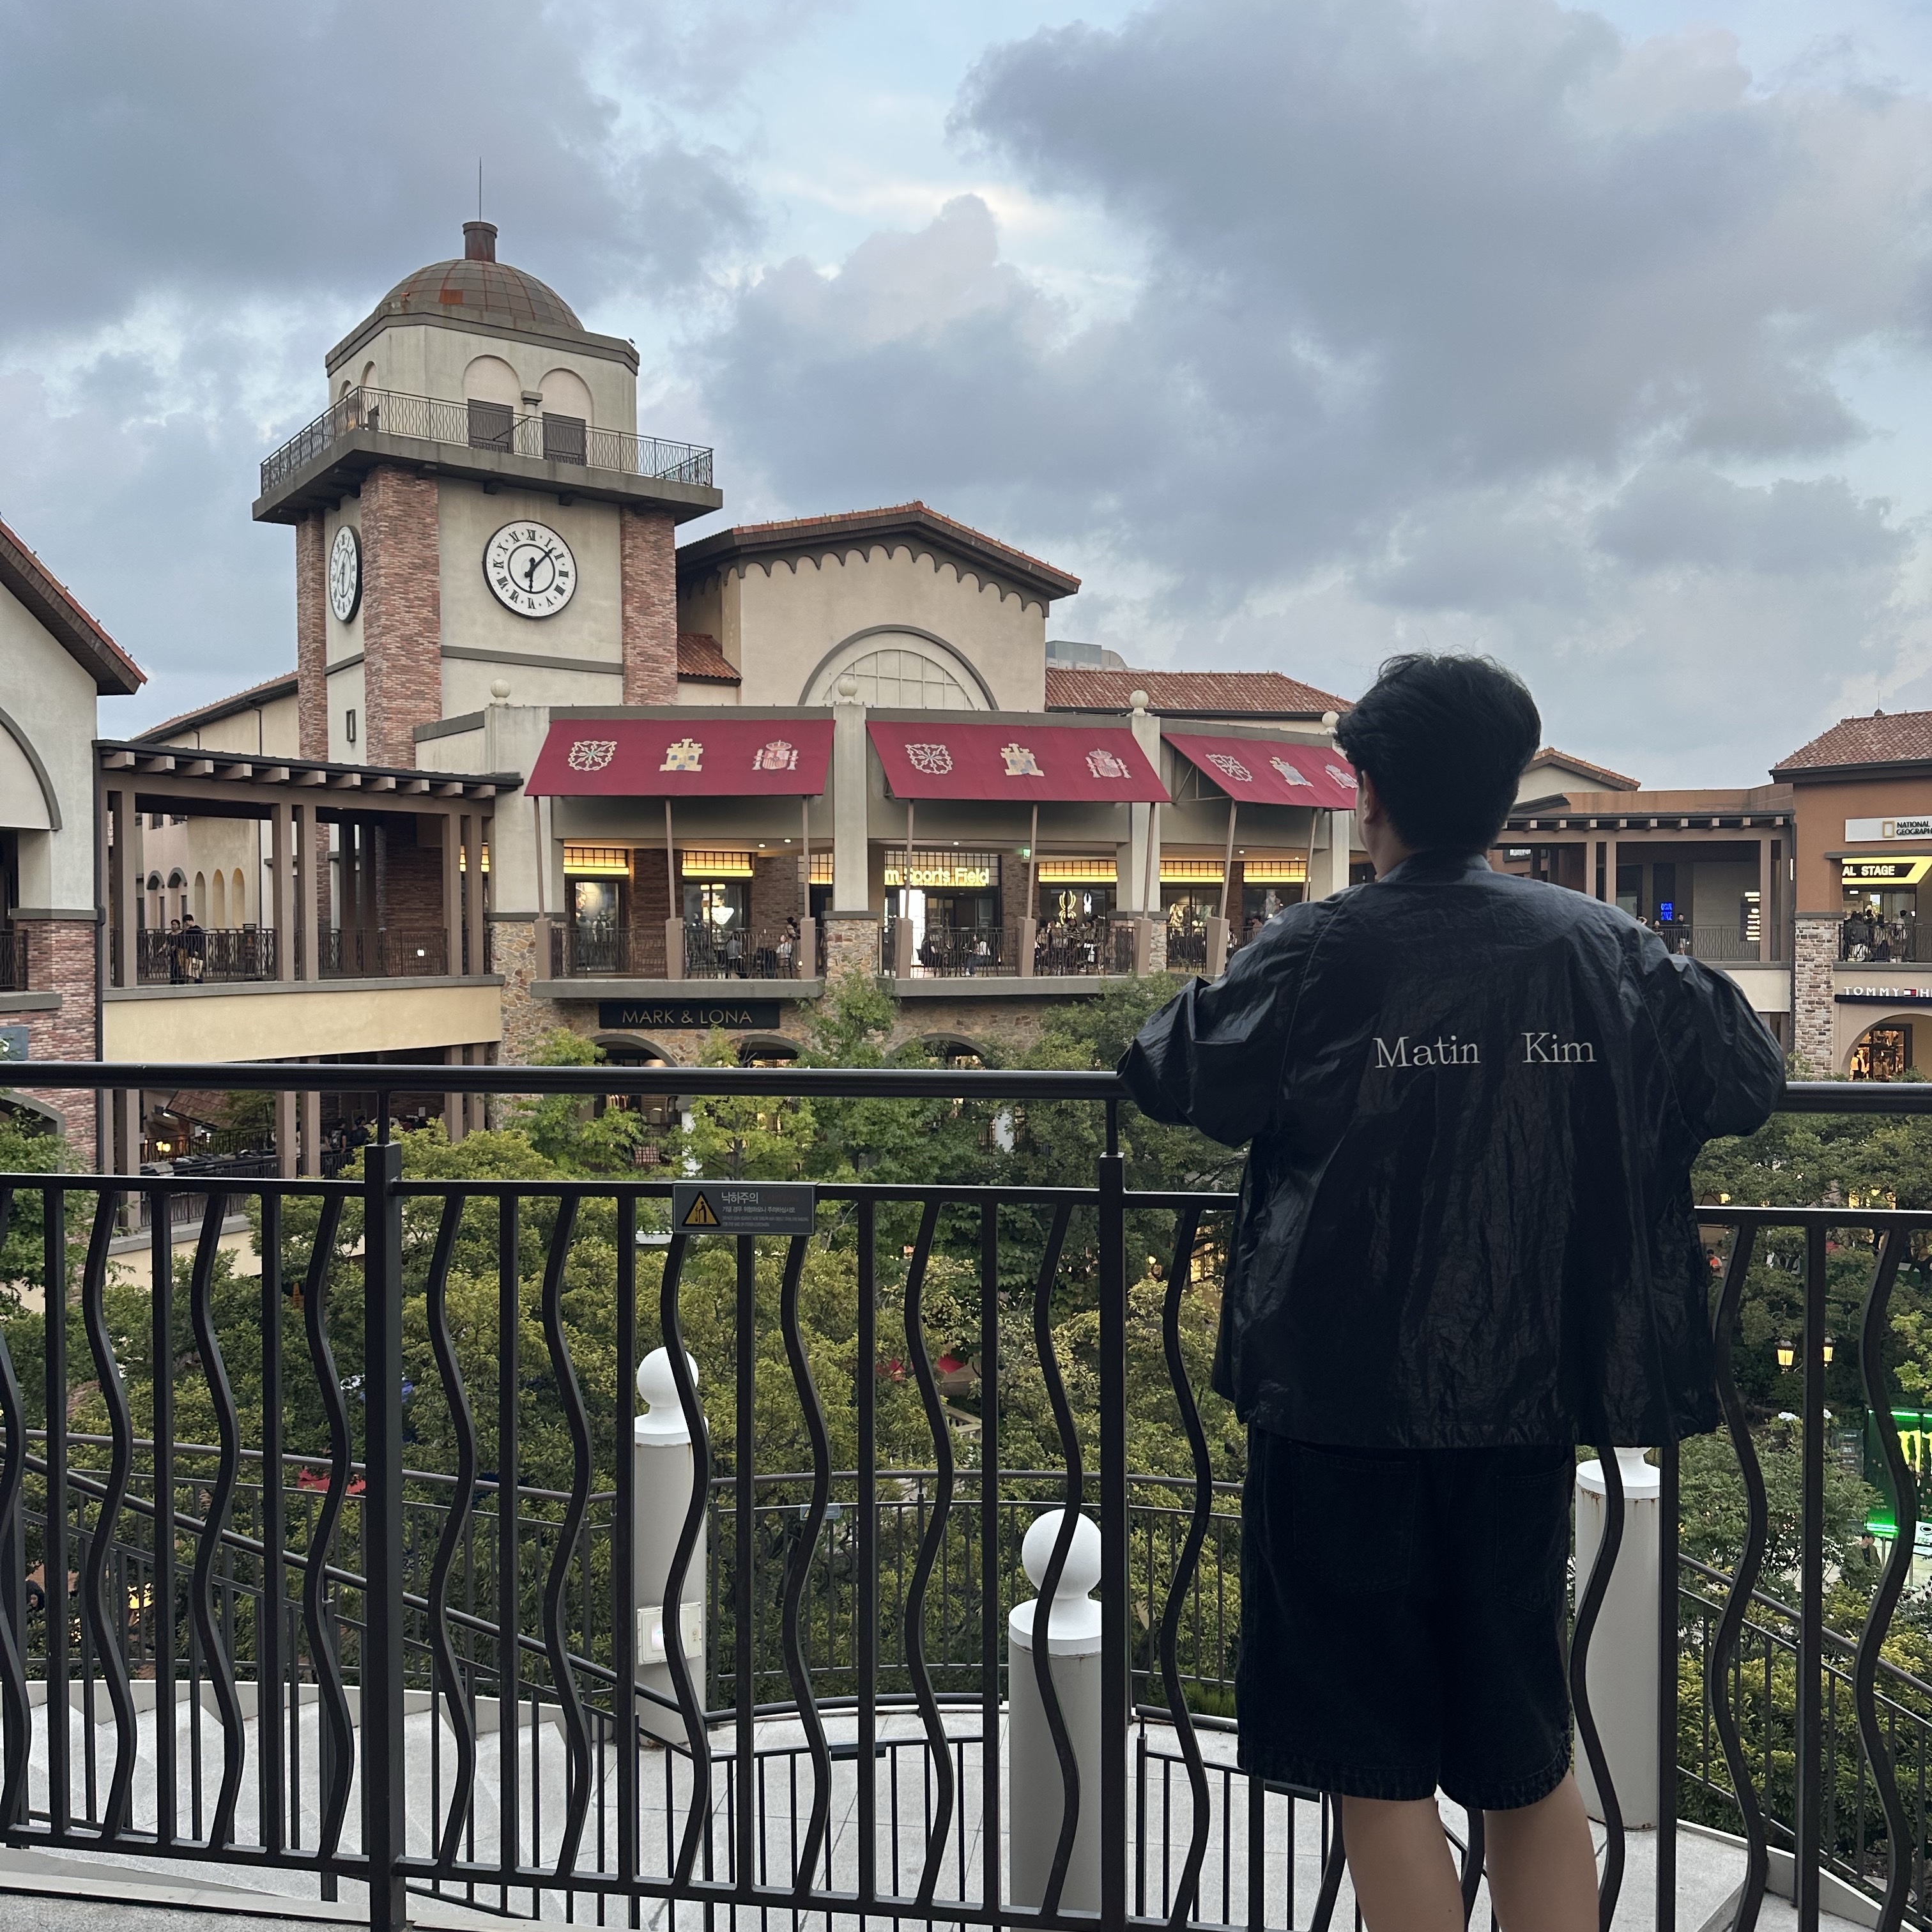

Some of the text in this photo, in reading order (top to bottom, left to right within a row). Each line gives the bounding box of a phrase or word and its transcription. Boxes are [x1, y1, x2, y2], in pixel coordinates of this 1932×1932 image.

[496, 542, 509, 555] X
[544, 537, 553, 548] I
[545, 595, 555, 607] V
[1897, 820, 1930, 829] NATIONAL
[904, 868, 951, 885] Sports
[955, 868, 990, 884] Field
[1842, 865, 1896, 876] AL STAGE
[1843, 986, 1900, 997] TOMMY
[622, 1009, 753, 1025] MARK & LONA
[1372, 1032, 1597, 1068] Matin Kim
[721, 1192, 758, 1204] 낙하주의
